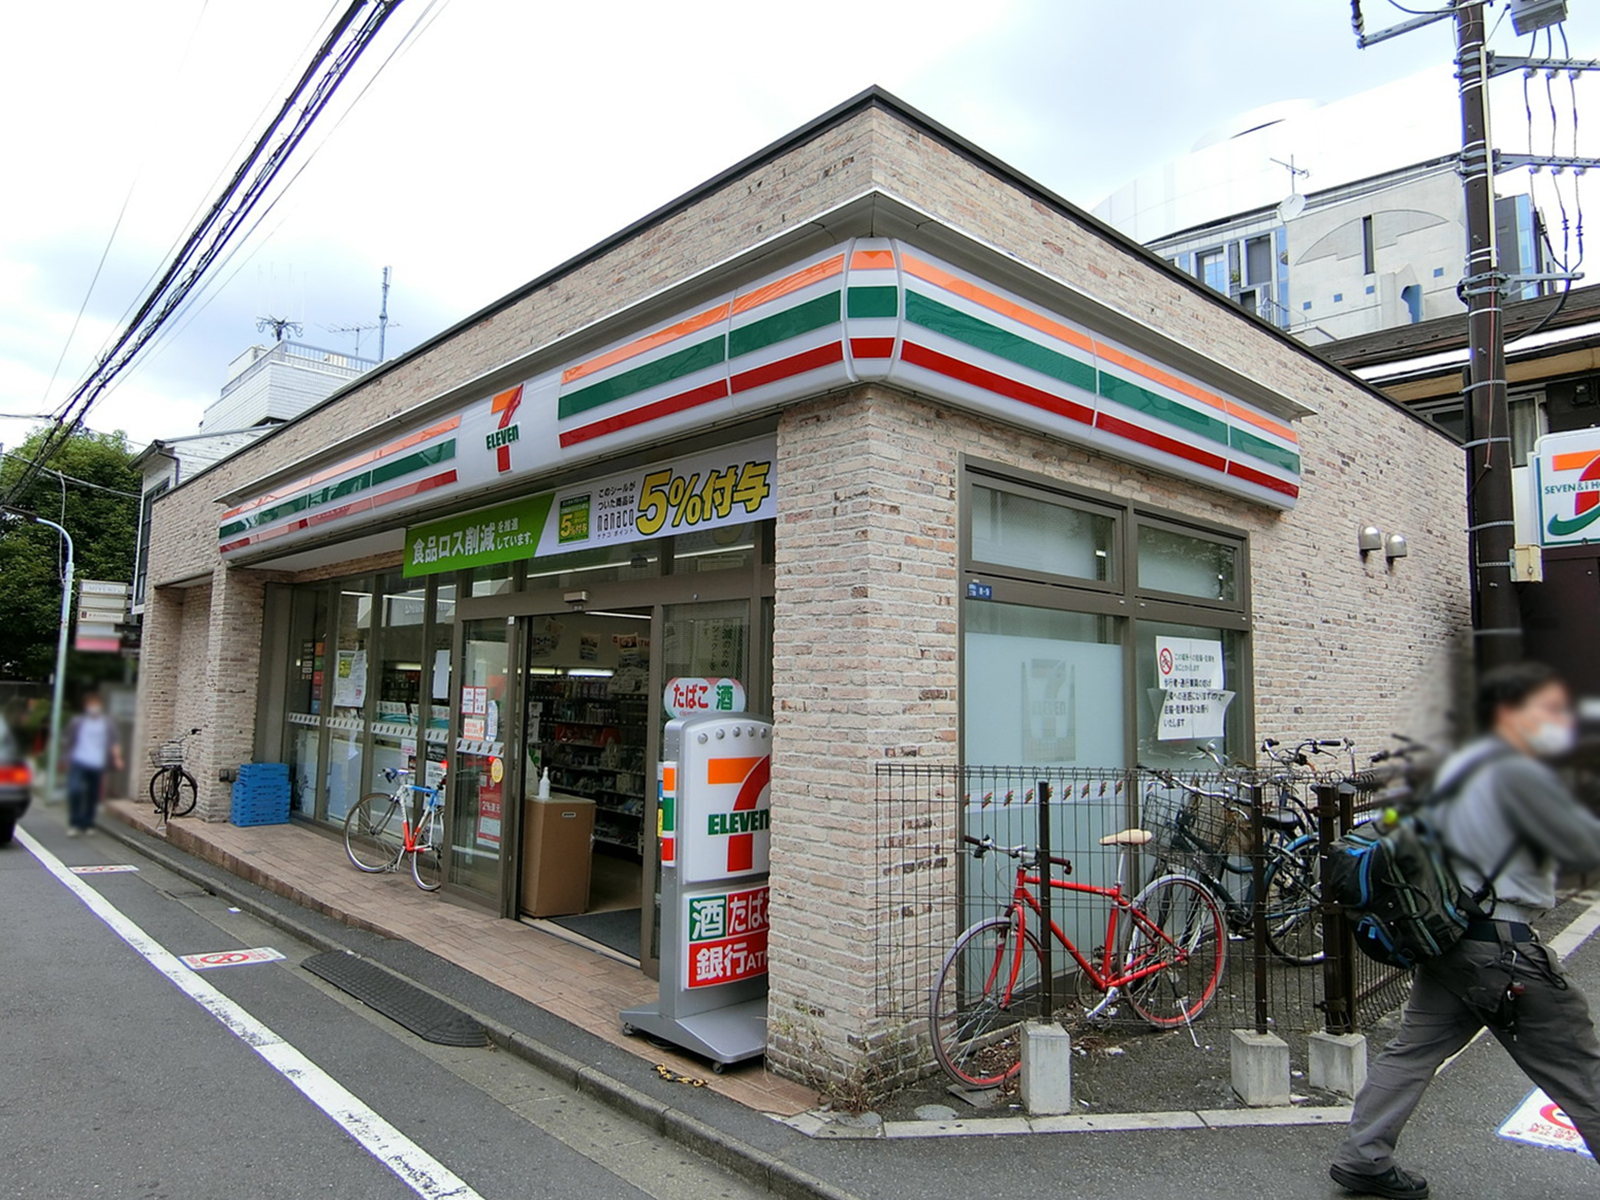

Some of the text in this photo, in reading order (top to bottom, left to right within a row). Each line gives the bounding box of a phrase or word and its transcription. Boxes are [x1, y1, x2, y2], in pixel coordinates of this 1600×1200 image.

[486, 424, 519, 450] ELEVEN
[491, 383, 524, 472] 7
[598, 481, 636, 498] このシールが
[635, 460, 771, 536] 5%付与
[598, 495, 635, 511] ついた商品は
[497, 517, 519, 533] を推進
[597, 508, 634, 532] nanaco
[412, 522, 496, 566] 食品ロス削減
[497, 532, 533, 550] しています。
[673, 683, 733, 711] たばこ 酒
[1163, 718, 1185, 728] いたします
[708, 753, 770, 872] 7
[708, 809, 769, 835] ELEVEN
[692, 898, 725, 940] 酒
